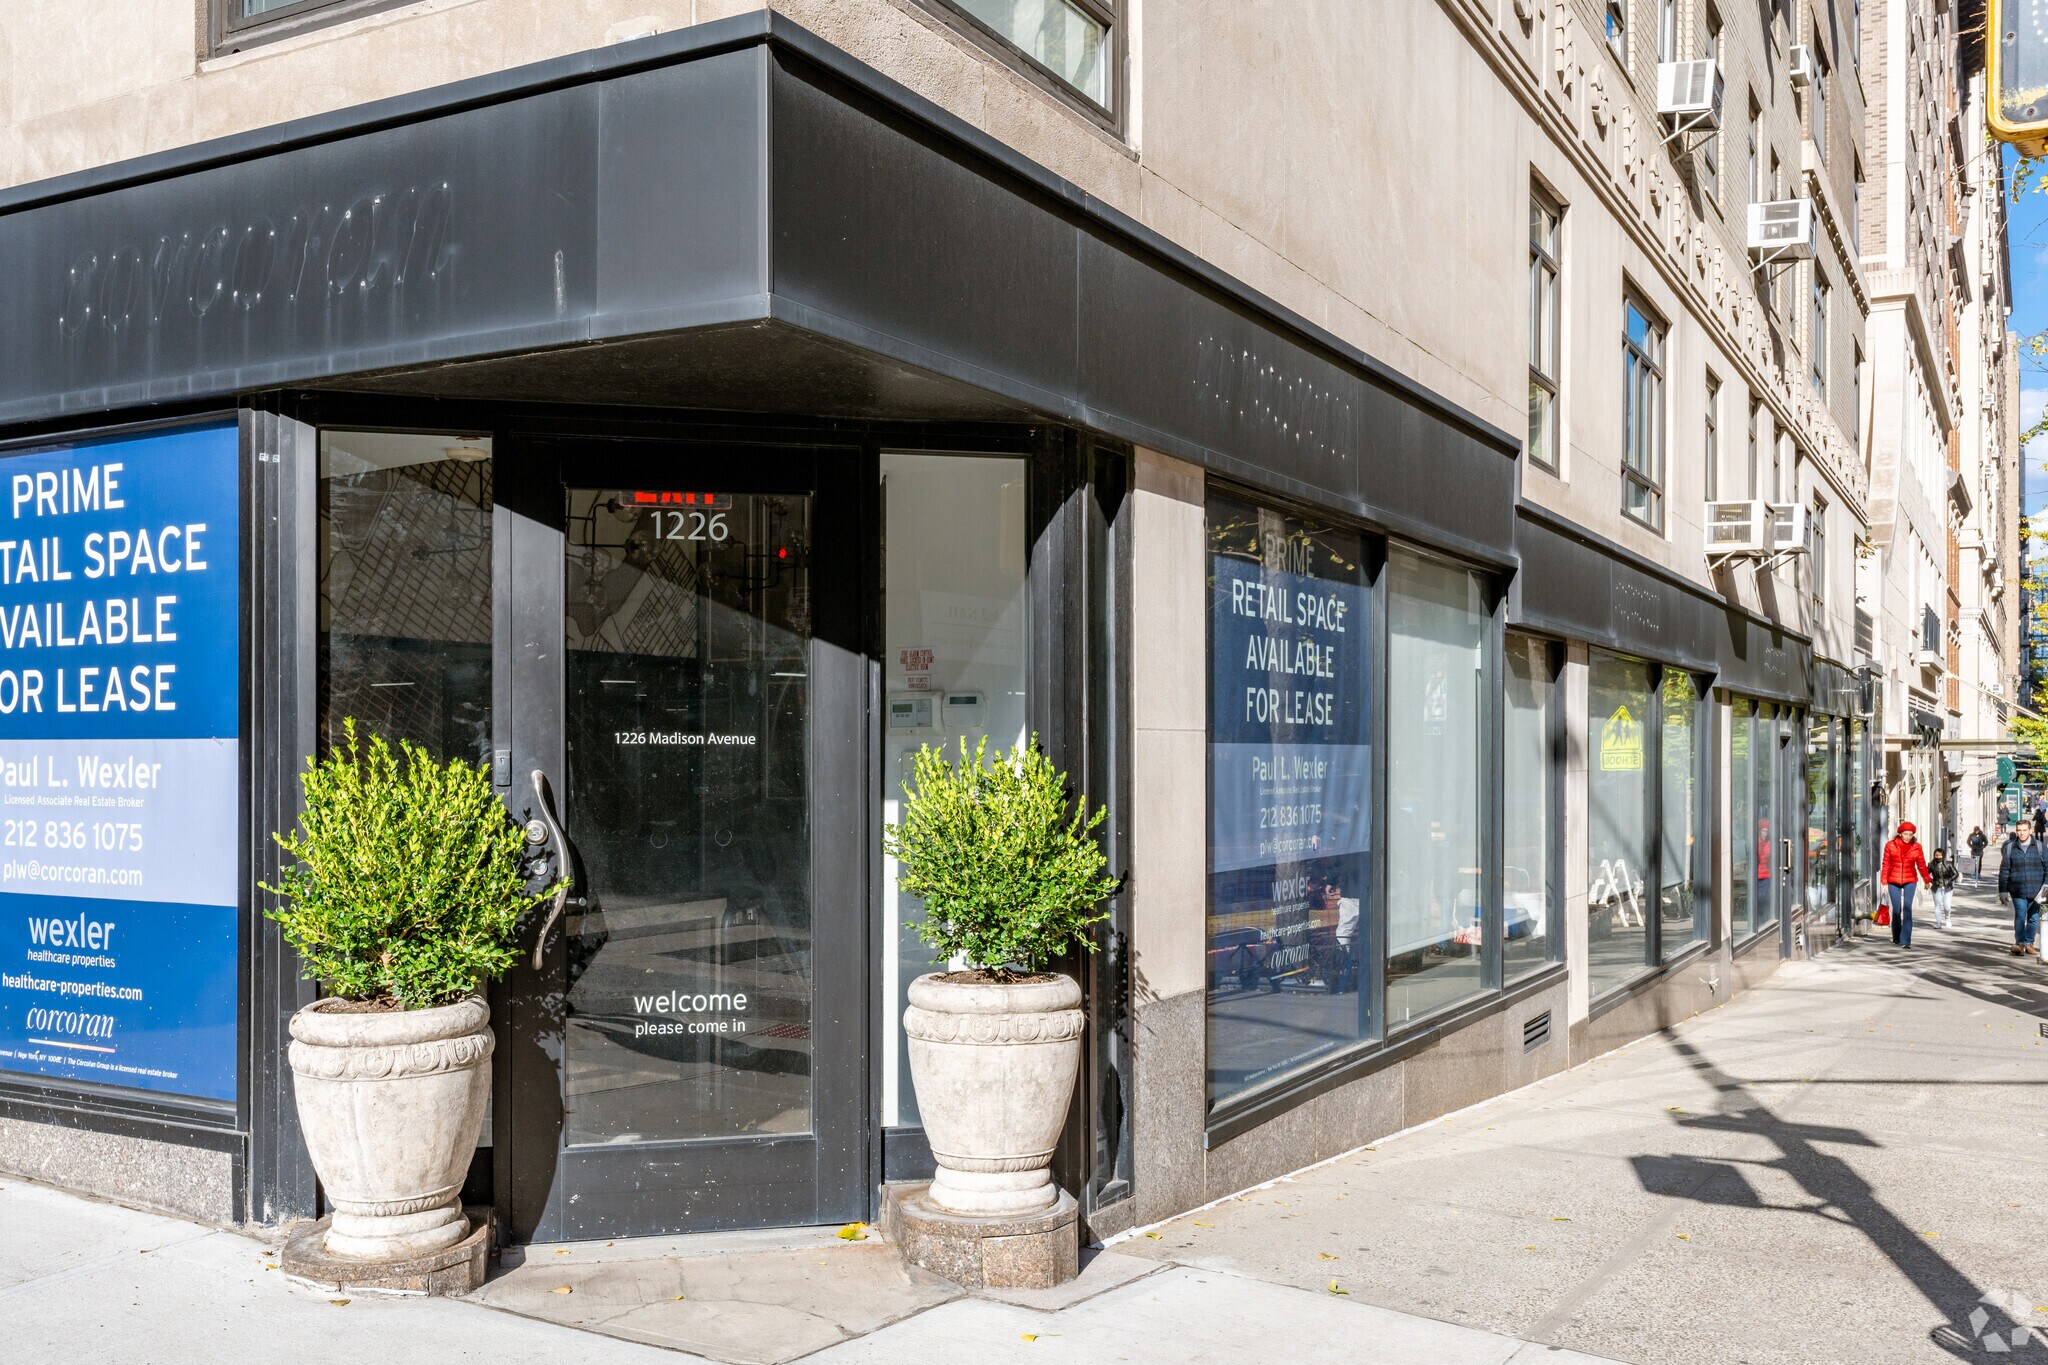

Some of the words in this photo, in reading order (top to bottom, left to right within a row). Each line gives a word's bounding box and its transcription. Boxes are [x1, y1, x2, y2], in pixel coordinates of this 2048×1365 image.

[13, 463, 124, 518] PRIME
[651, 511, 728, 541] 1226
[0, 537, 71, 584] TAIL
[84, 523, 207, 579] SPACE
[1265, 533, 1315, 578] PRIME
[1232, 579, 1293, 623] RETAIL
[1297, 592, 1346, 632] SPACE
[0, 596, 177, 648] VAILABLE
[1246, 634, 1334, 678] AVAILABLE
[0, 669, 43, 714] OR
[57, 665, 176, 712] LEASE
[1246, 687, 1279, 723] FOR
[1285, 690, 1334, 725] LEASE
[614, 732, 646, 745] 1226
[649, 732, 704, 745] Madison
[707, 732, 756, 745] Avenue
[0, 755, 38, 787] aul
[48, 755, 68, 788] L.
[78, 755, 161, 789] Wexler
[1252, 756, 1277, 781] Paul
[1281, 756, 1290, 780] L.
[1294, 756, 1328, 779] Wexler
[4, 794, 35, 805] Licensed
[37, 795, 72, 806] Associate
[74, 795, 90, 806] Real
[92, 796, 115, 807] Estate
[118, 796, 144, 808] Broker
[1260, 807, 1278, 828] 212
[1280, 805, 1299, 827] 836
[1300, 803, 1321, 824] 1075
[4, 819, 37, 847] 212
[45, 820, 86, 850] 836
[92, 822, 142, 852] 1075
[4, 859, 142, 886] plw@corcoran.com
[1272, 872, 1310, 902] wexler
[29, 912, 115, 950] wexler
[27, 949, 70, 965] healthcare
[72, 952, 115, 969] properties
[2, 972, 142, 1001] healthcare-properties.com
[634, 990, 747, 1013] welcome
[26, 1007, 114, 1038] corcoran
[635, 1022, 683, 1038] please
[688, 1021, 728, 1034] come
[733, 1019, 746, 1032] in
[68, 1057, 76, 1066] The
[97, 1061, 110, 1070] Group
[162, 1070, 178, 1079] broker
